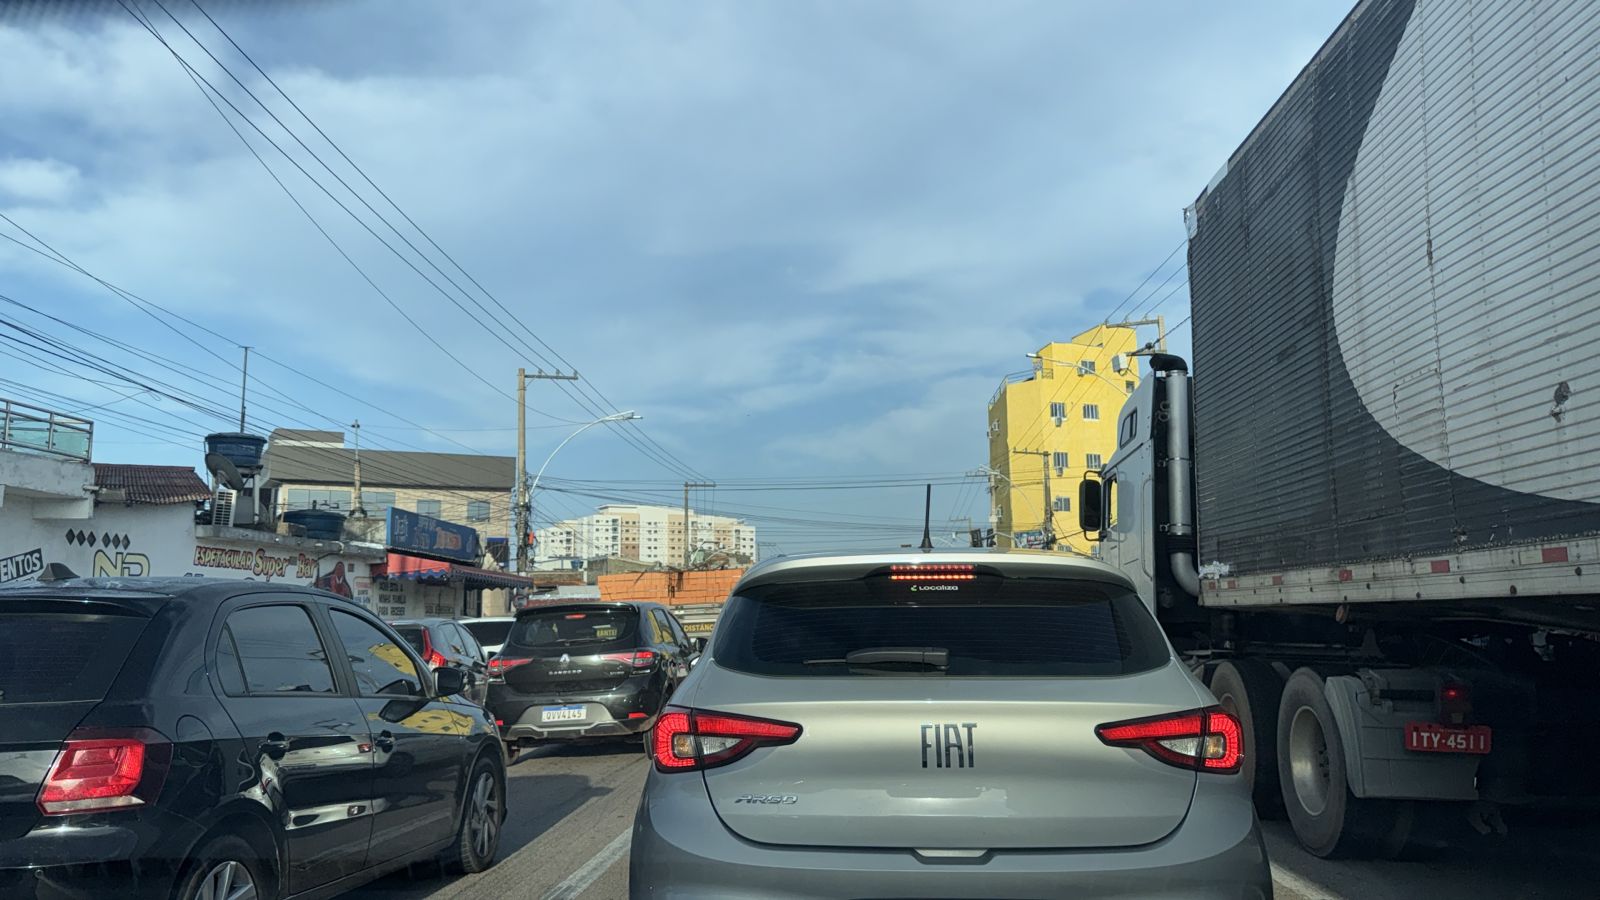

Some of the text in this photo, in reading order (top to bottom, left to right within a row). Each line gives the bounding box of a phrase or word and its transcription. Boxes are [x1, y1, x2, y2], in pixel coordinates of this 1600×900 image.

[0, 552, 42, 581] ENTOS
[253, 548, 289, 582] Super
[296, 553, 317, 578] Bar
[921, 722, 977, 768] FIAT
[734, 793, 798, 804] ARGO
